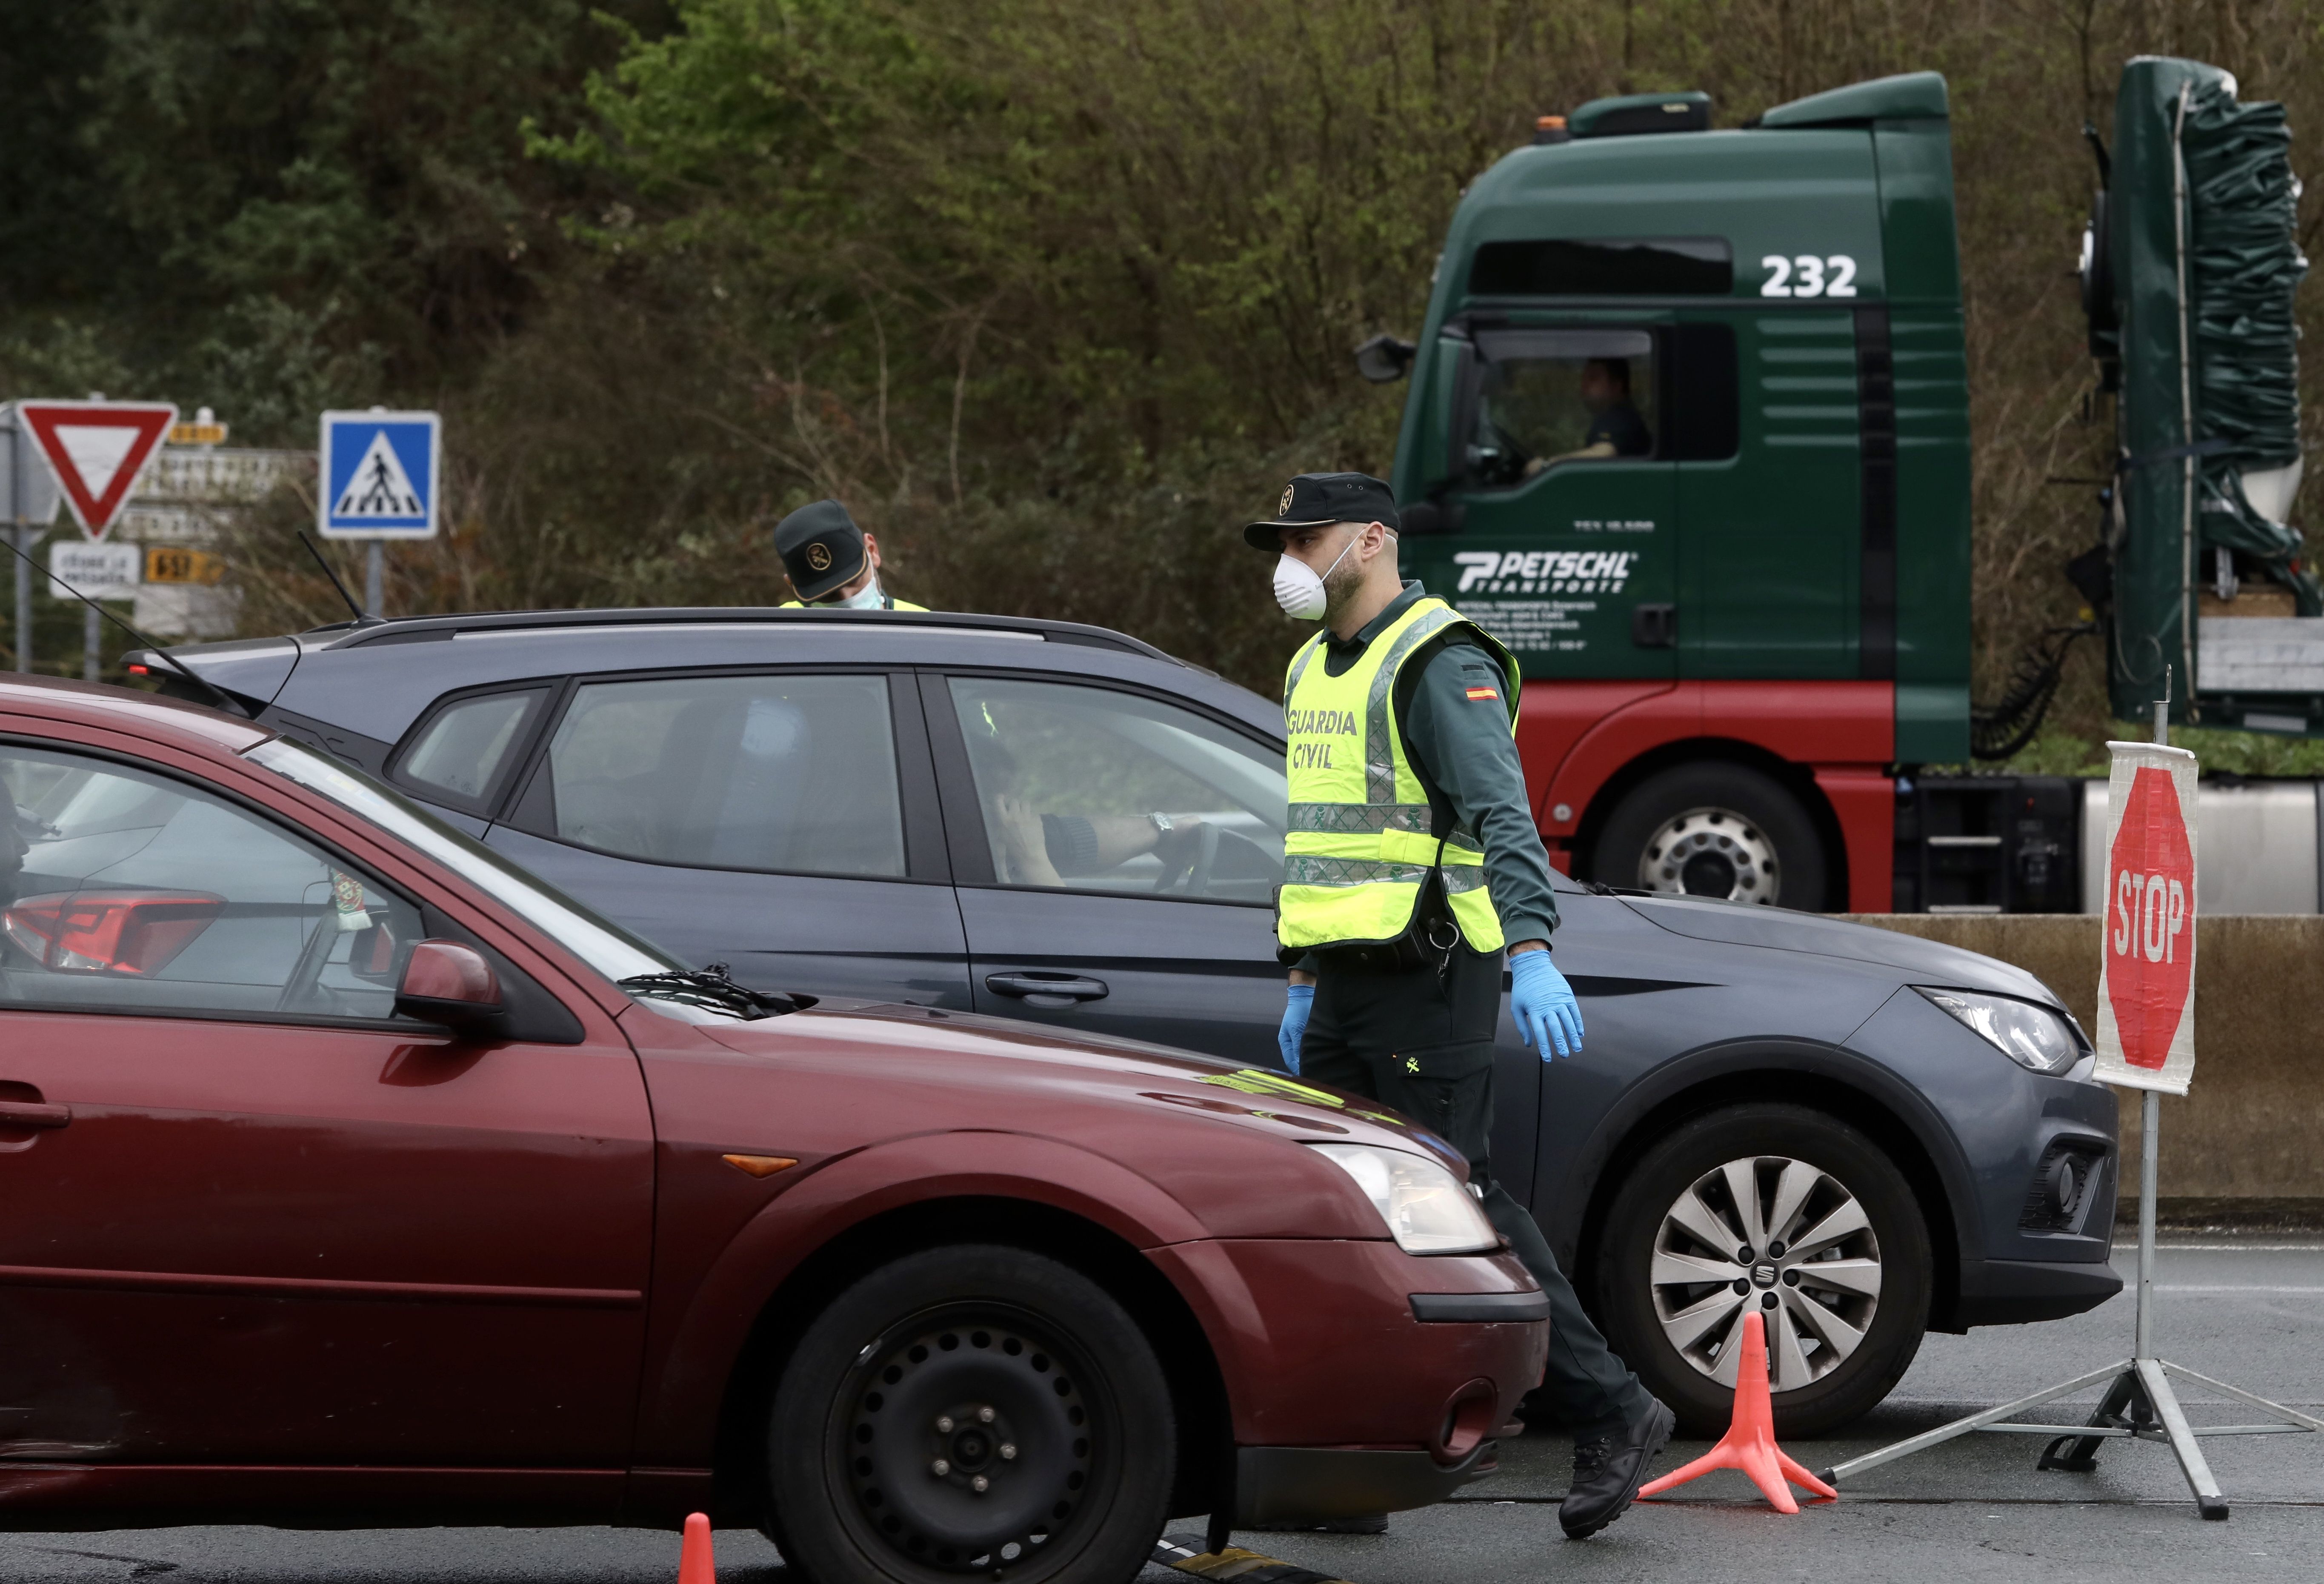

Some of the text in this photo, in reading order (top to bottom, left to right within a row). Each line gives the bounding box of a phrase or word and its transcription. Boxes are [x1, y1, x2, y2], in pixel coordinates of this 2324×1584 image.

[1760, 254, 1858, 297] 232
[1497, 552, 1629, 579] PETSCHL
[1476, 579, 1624, 594] TRANSPORTE
[1288, 709, 1357, 736] GUARDIA
[1293, 743, 1332, 769] CIVIL
[2114, 869, 2184, 964] STOP
